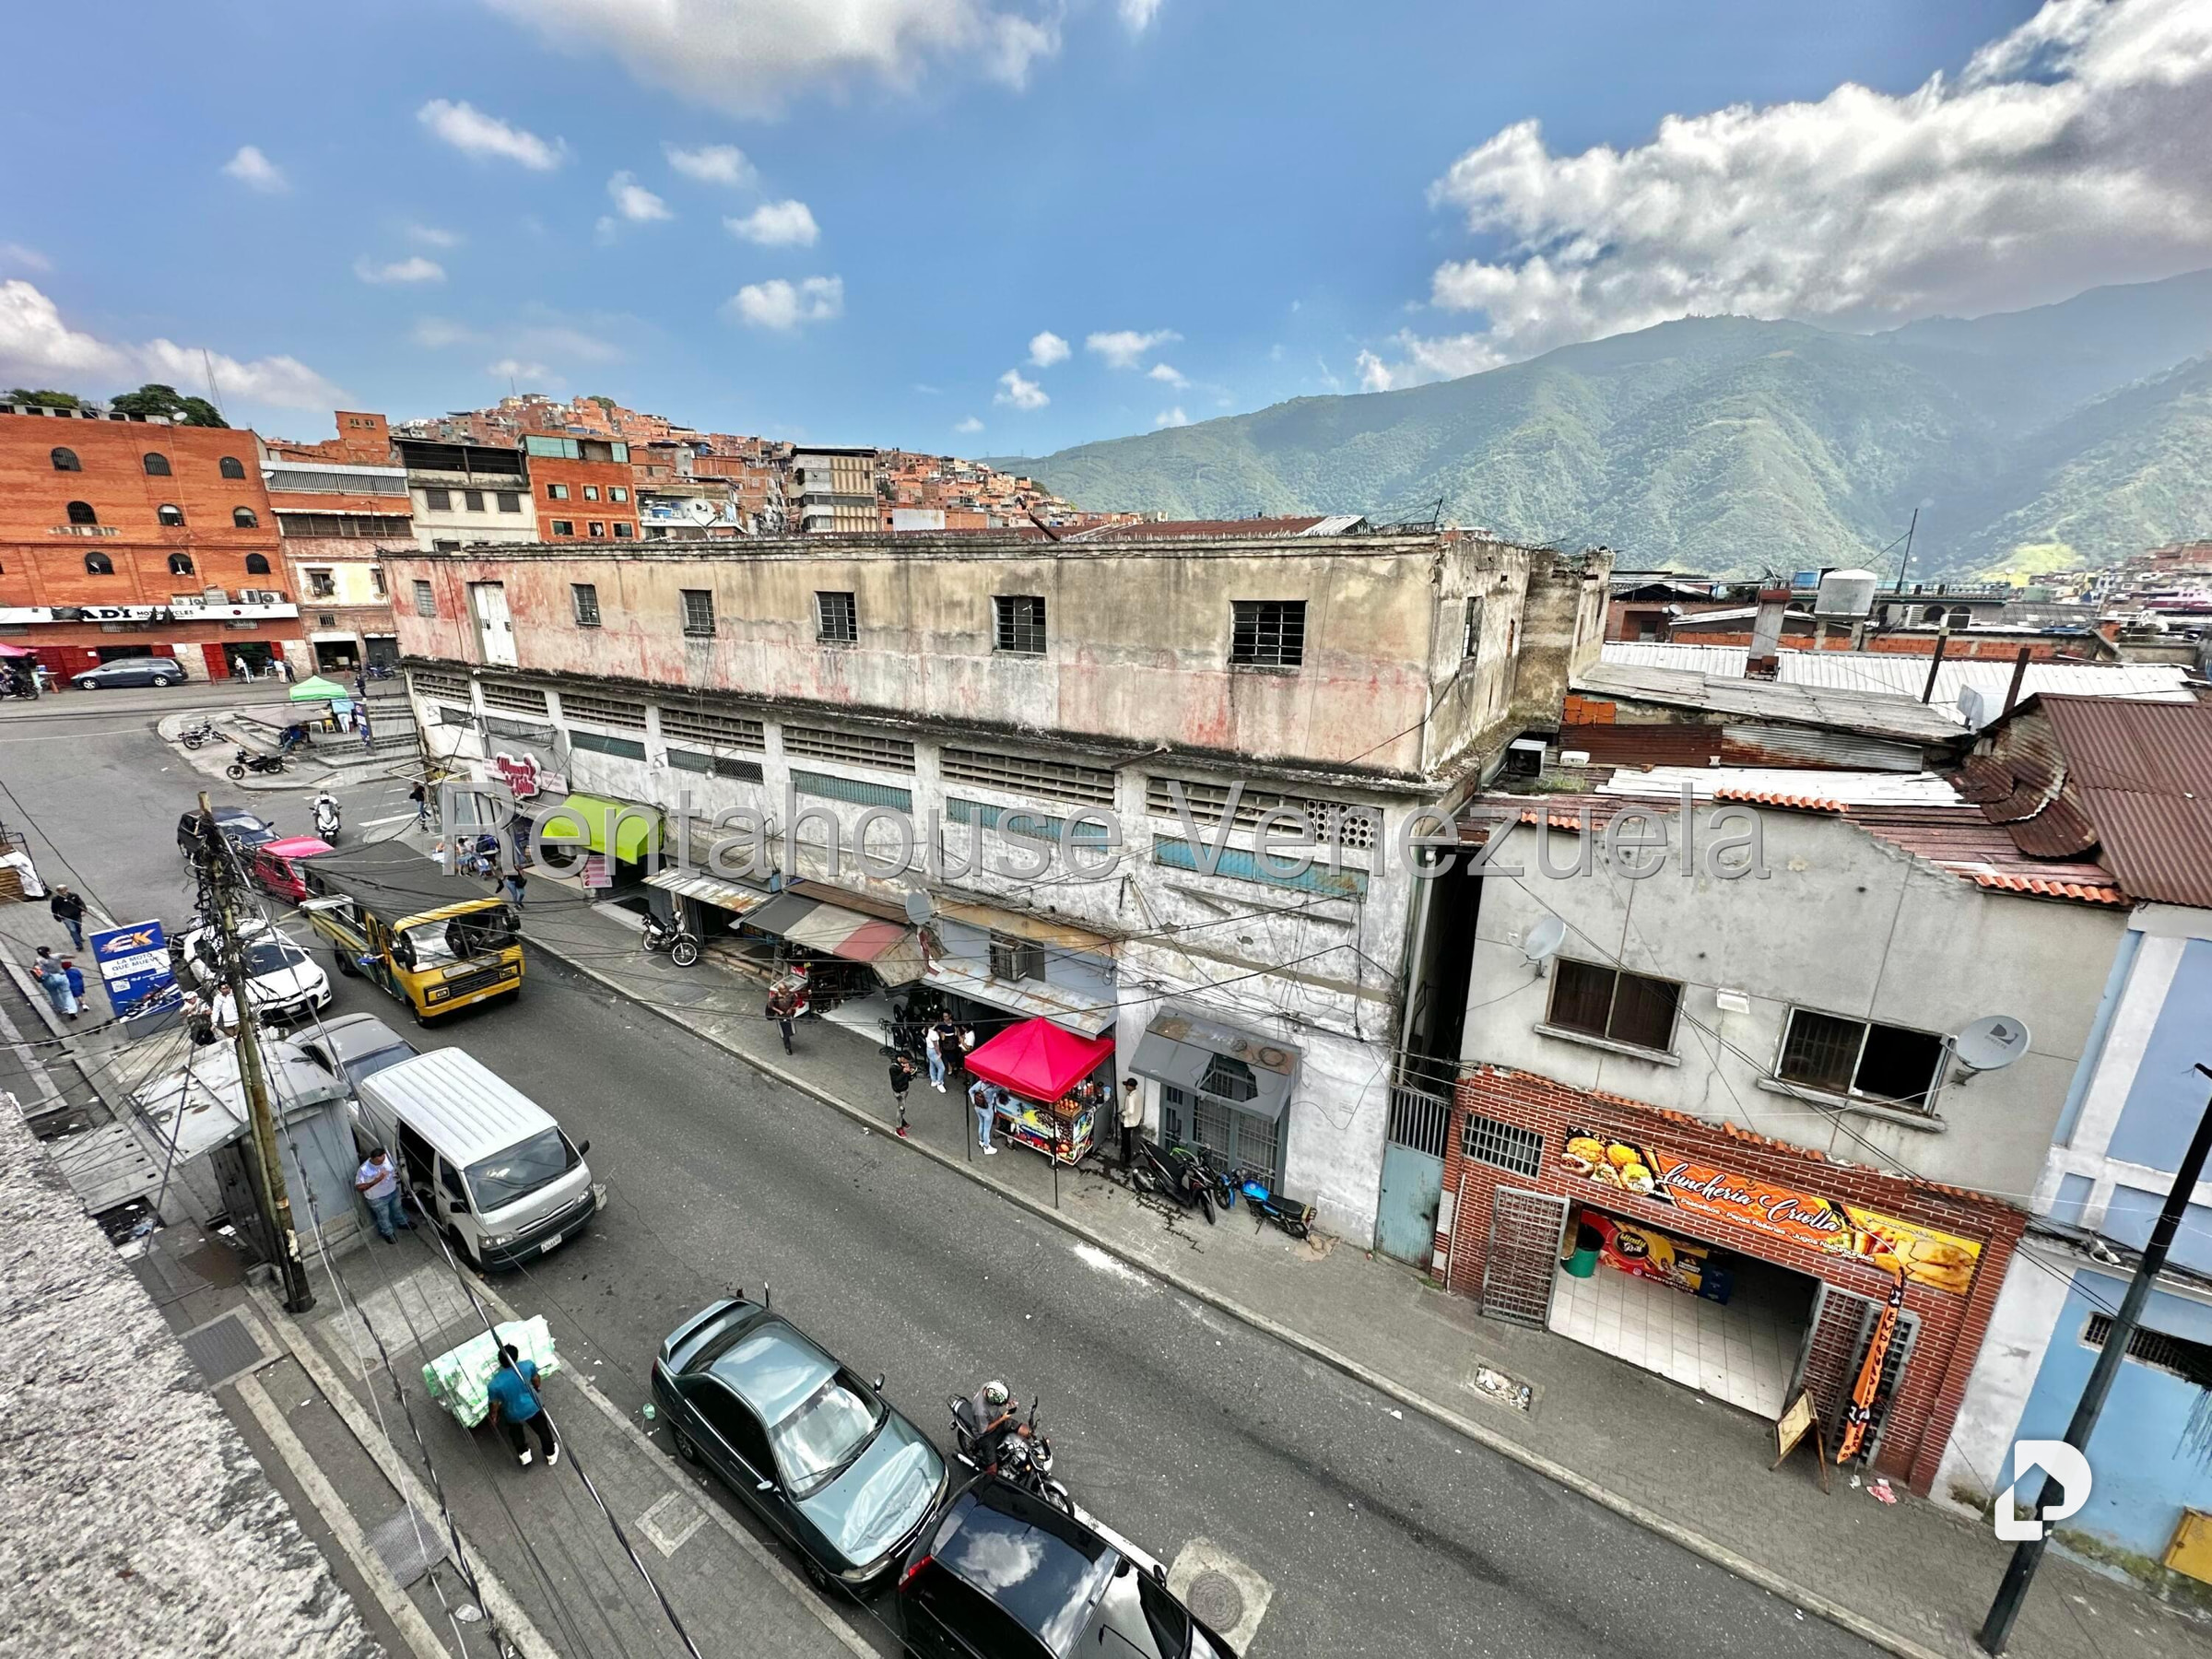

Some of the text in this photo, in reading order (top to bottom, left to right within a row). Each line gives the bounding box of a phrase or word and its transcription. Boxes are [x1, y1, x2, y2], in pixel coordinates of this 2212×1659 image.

[112, 963, 129, 971] QUE
[129, 952, 153, 961] MOTO
[1759, 1194, 1842, 1233] Criolla
[1726, 1211, 1751, 1225] Papas
[1751, 1219, 1786, 1235] Rellenas
[1792, 1232, 1818, 1246] Jugos
